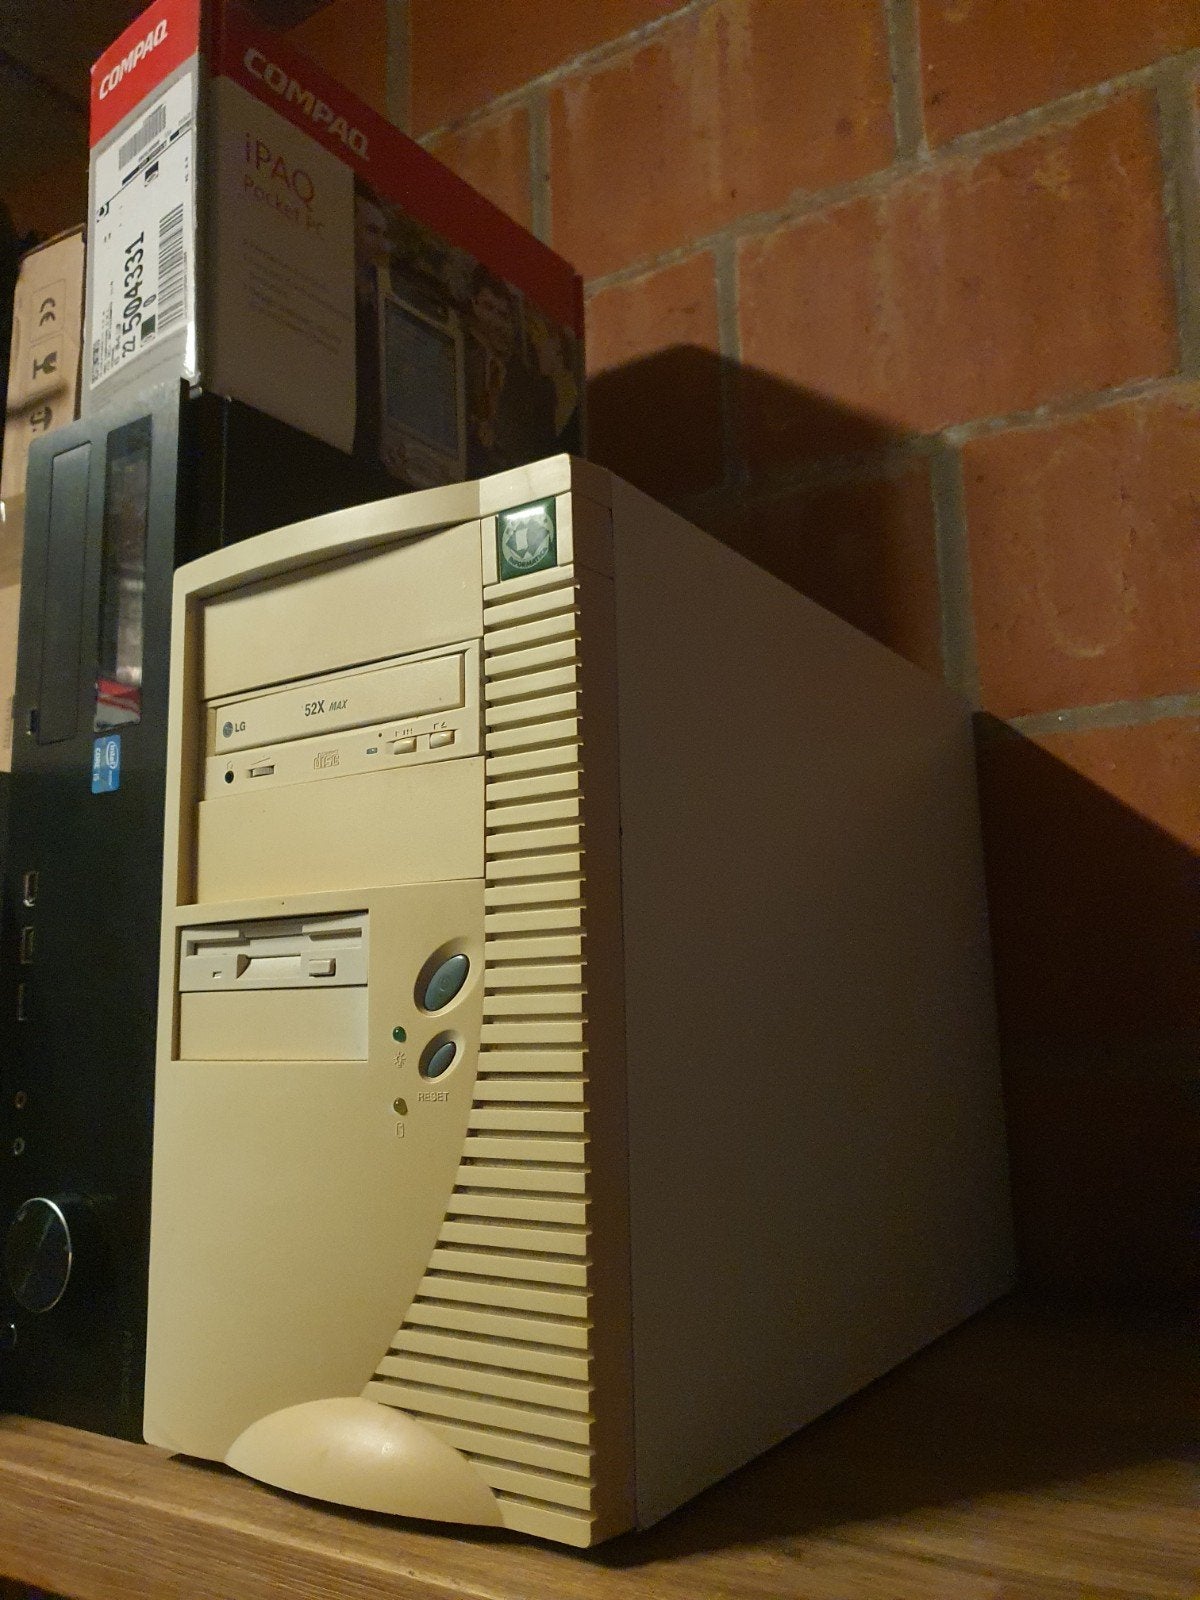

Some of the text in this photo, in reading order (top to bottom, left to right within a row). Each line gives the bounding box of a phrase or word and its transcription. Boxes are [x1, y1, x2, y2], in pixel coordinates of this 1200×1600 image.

[99, 19, 168, 100] COMPAQ
[243, 48, 370, 161] COMPAQ
[244, 132, 314, 204] iPAQ
[122, 231, 145, 335] 504331
[234, 721, 246, 733] LG
[304, 699, 349, 717] 52X MAX
[418, 1091, 450, 1102] RESET
